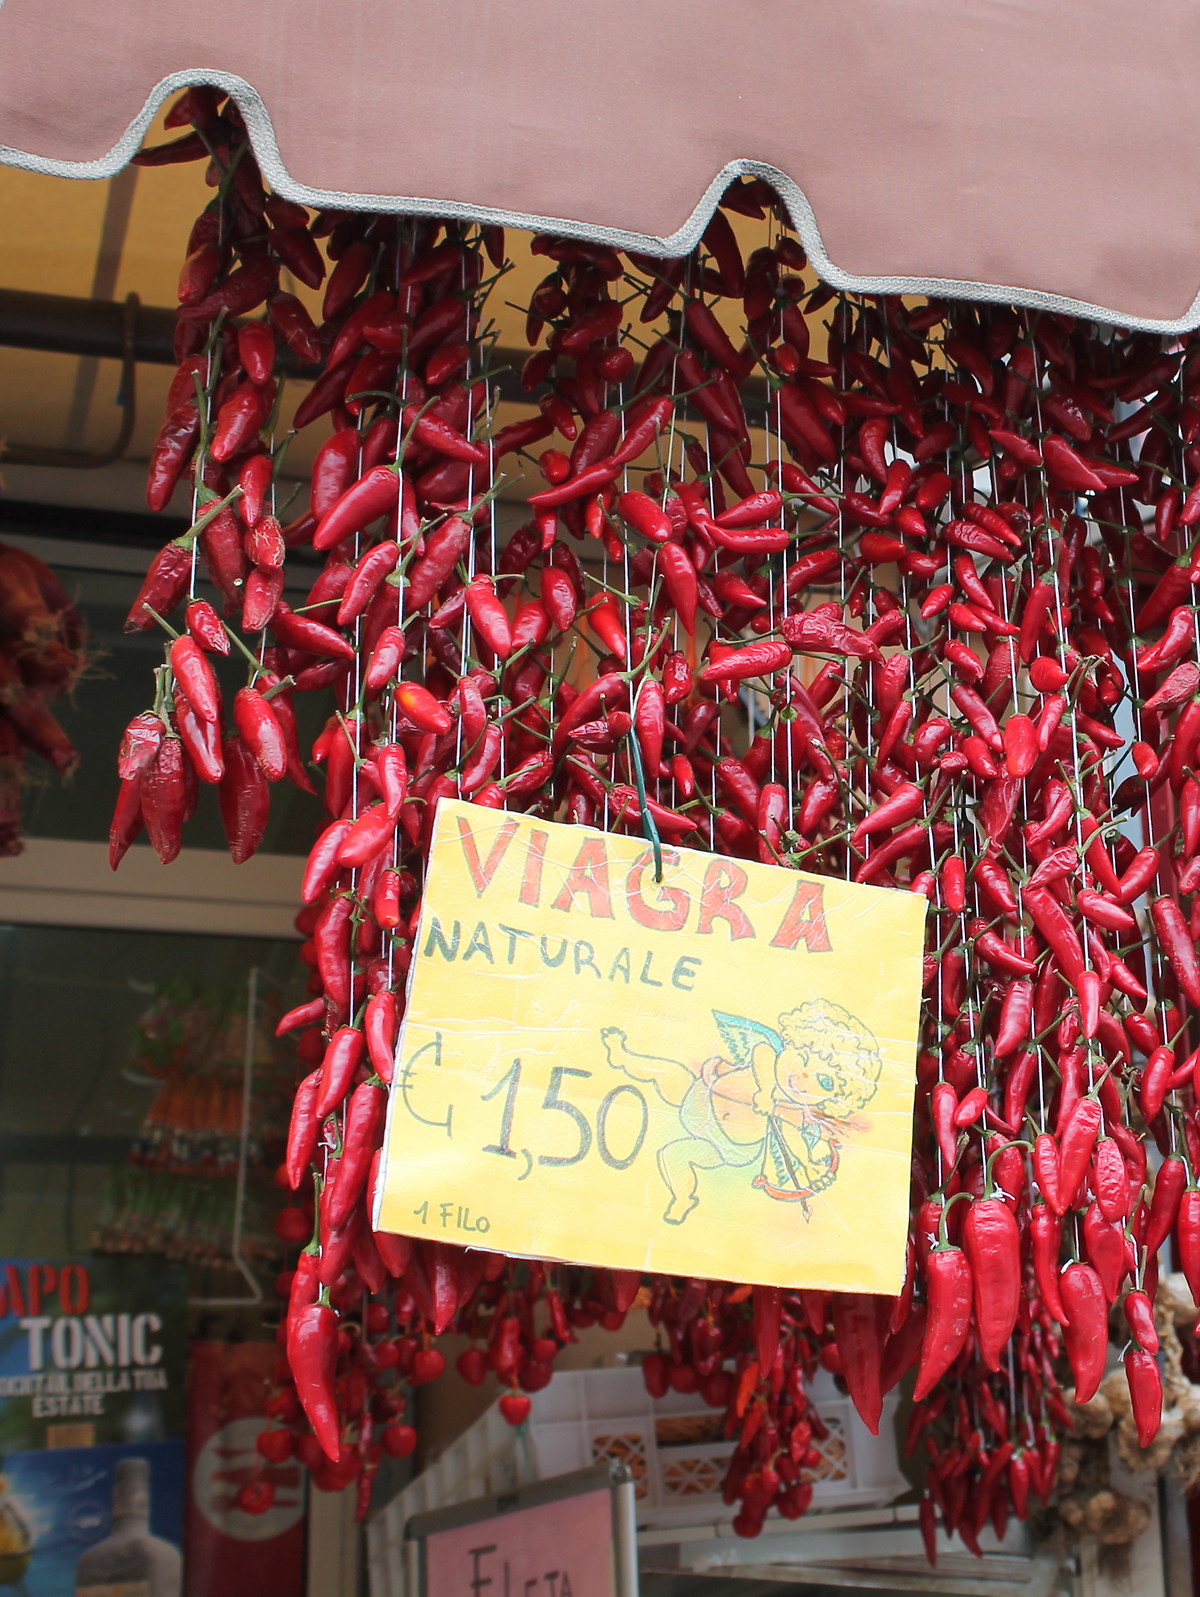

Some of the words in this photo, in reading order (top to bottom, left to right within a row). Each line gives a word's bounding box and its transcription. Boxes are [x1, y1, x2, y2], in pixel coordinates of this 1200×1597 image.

[456, 815, 833, 954] VIAGRA
[423, 916, 702, 993] NATURALE
[481, 1057, 650, 1182] 1,50
[413, 1200, 430, 1225] 1
[19, 1313, 162, 1370] TONIC
[34, 1394, 103, 1417] ESTATE
[73, 1371, 131, 1394] DELLA
